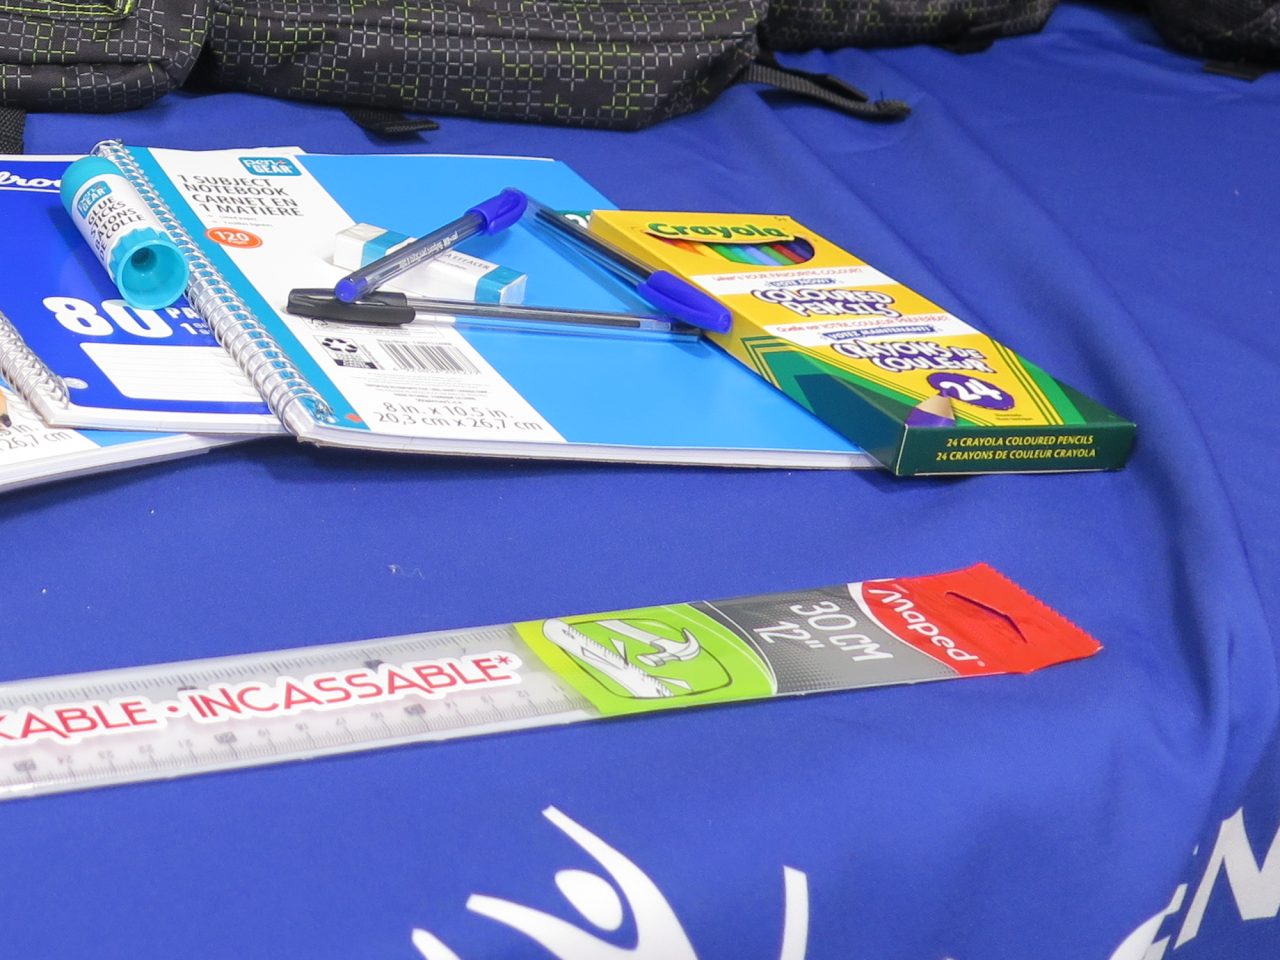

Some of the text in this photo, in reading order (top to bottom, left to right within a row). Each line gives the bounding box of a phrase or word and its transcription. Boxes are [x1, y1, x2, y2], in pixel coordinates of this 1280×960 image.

[177, 174, 273, 188] 1 SUBJECT
[183, 182, 290, 197] NOTEBOOK
[192, 193, 299, 208] CARNET EN
[199, 203, 211, 212] 1
[88, 196, 115, 226] GLUE
[90, 200, 127, 238] STICKS
[105, 214, 146, 240] COLLE
[214, 230, 251, 242] 120
[647, 222, 790, 239] Crayola
[751, 288, 895, 306] COLOURED
[42, 296, 173, 338] 80
[779, 301, 902, 318] PENCILS
[831, 340, 987, 360] CRAYONS DE
[872, 356, 997, 374] COULEUR
[939, 378, 1003, 401] 24
[383, 401, 398, 413] 8
[428, 406, 443, 416] x
[444, 404, 485, 418] 10.5
[373, 412, 544, 431] 20,3 cm x 26,7 cm
[2, 432, 40, 450] 26,7
[42, 430, 74, 442] cm
[946, 435, 1094, 447] 24 CRAYOLA COLOURED PENCILS
[936, 448, 1096, 461] 24 CRAYONS DE COULEUR CRAYOLA
[789, 600, 894, 662] 30 CM
[867, 588, 979, 661] Maped
